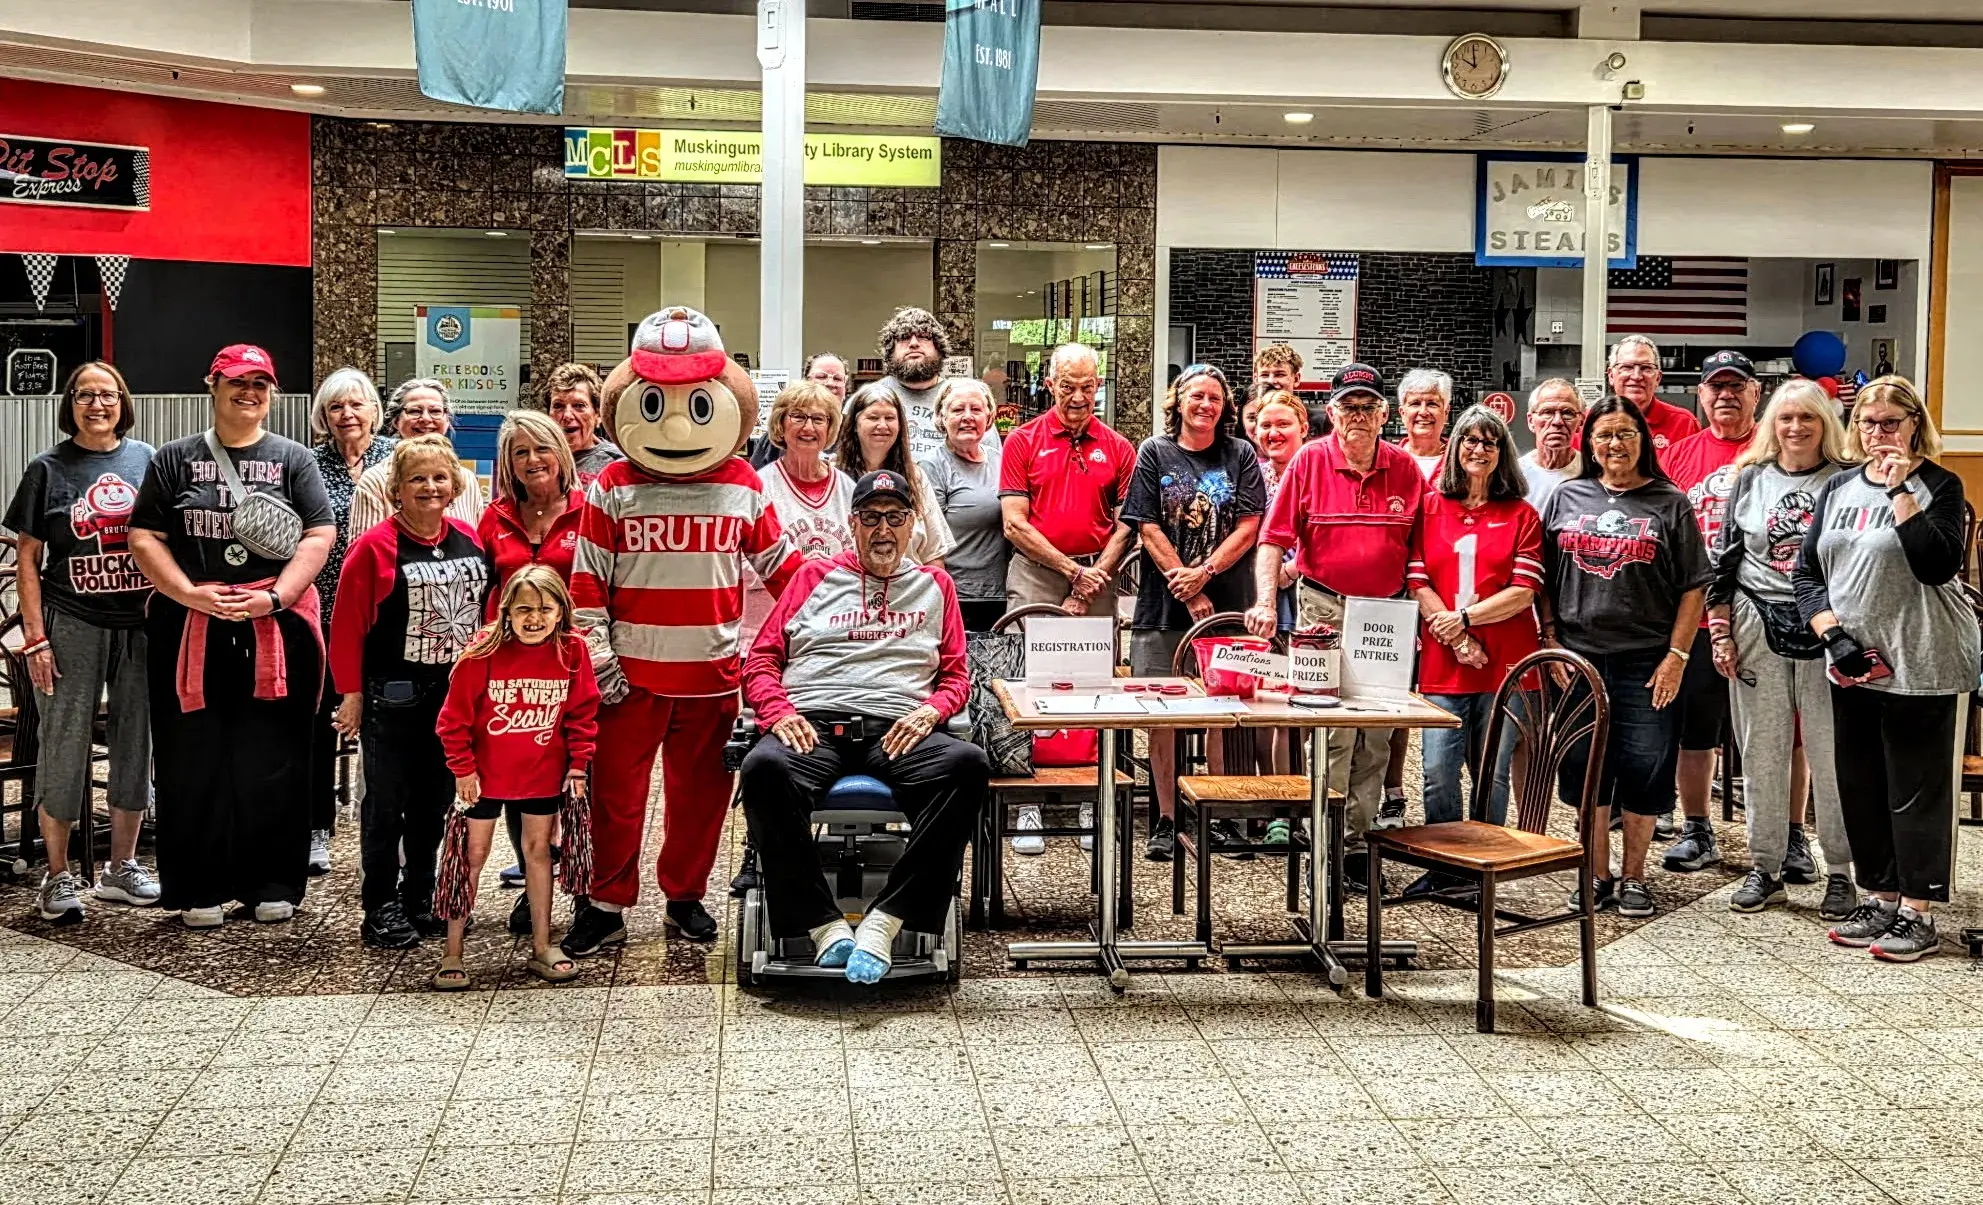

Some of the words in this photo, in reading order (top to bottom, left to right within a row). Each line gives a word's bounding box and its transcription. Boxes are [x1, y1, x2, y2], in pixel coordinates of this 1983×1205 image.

[975, 43, 993, 66] EST.
[995, 47, 1012, 70] 1981
[564, 135, 661, 176] MCLS
[674, 139, 761, 158] Muskingum
[823, 142, 874, 162] Library
[878, 143, 933, 162] System
[41, 147, 118, 190] Stop
[674, 160, 764, 175] muskingumlibra
[12, 175, 82, 199] Express
[1490, 230, 1620, 252] STEAS
[433, 364, 461, 374] FREE
[464, 364, 504, 376] BOOKS
[458, 378, 483, 390] KIDS
[240, 460, 283, 485] FIRM
[624, 516, 743, 552] BRUTUS
[1558, 532, 1657, 560] CHAMPIONS
[401, 556, 488, 587] BUCKEYE
[829, 611, 870, 629] OHIO
[877, 610, 926, 631] STATE
[1363, 622, 1394, 634] DOOR
[1031, 642, 1111, 652] REGISTRATION
[1362, 636, 1394, 647] PRIZE
[1216, 647, 1271, 665] Donations
[1294, 655, 1326, 667] DOOR
[1353, 649, 1399, 662] ENTRIES
[488, 680, 505, 689] ON
[1292, 670, 1329, 682] PRIZES
[487, 688, 518, 704] WE
[486, 703, 561, 736] Scarle
